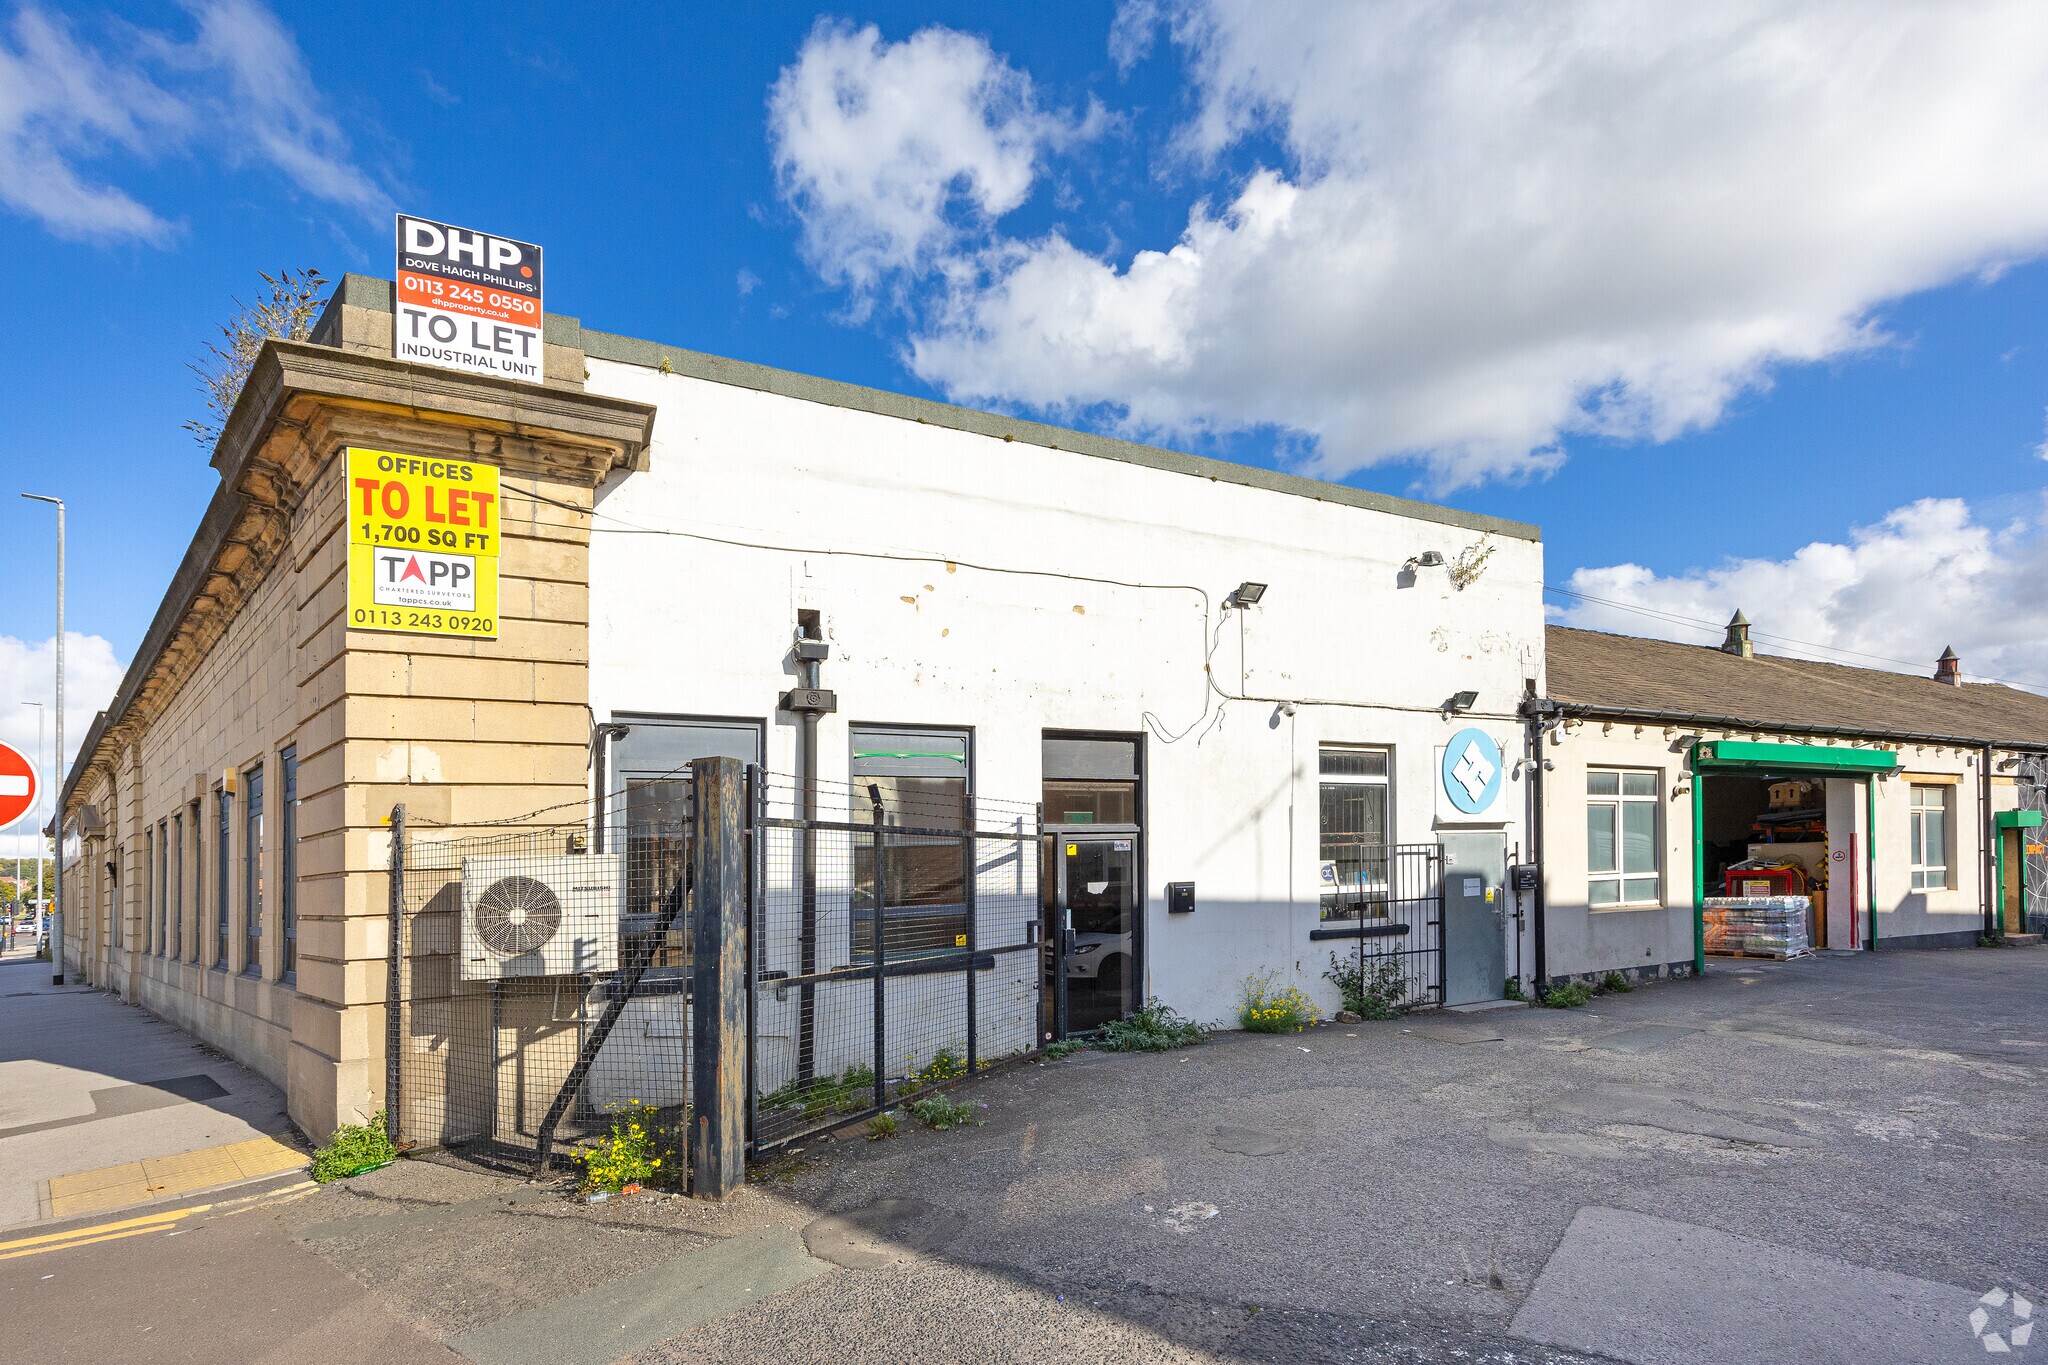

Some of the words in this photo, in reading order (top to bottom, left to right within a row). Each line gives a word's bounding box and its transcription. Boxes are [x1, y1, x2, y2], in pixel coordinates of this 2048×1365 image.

[406, 258, 439, 272] DOVE
[442, 264, 480, 280] HAIGH
[483, 274, 533, 292] PHILLIPS
[404, 276, 444, 295] 0113
[449, 285, 484, 303] 245
[489, 294, 534, 314] 0550
[432, 298, 510, 319] dhpproperty.co.uk
[404, 308, 457, 343] TO
[471, 322, 536, 358] LET
[402, 342, 498, 370] INDUSTRIAL
[502, 360, 537, 376] UNIT
[378, 455, 473, 482] OFFICES
[355, 478, 410, 519] TO
[425, 486, 494, 528] LET
[362, 523, 420, 544] 1,700
[428, 529, 457, 548] SQ
[465, 533, 489, 550] FT
[380, 554, 471, 588] TAPP
[379, 586, 425, 595] CHARTERED
[427, 590, 471, 599] SURVEYORS
[398, 596, 452, 607] tappcs.co.uk
[354, 609, 401, 626] 0113
[409, 613, 443, 628] 243
[449, 616, 493, 632] 0920
